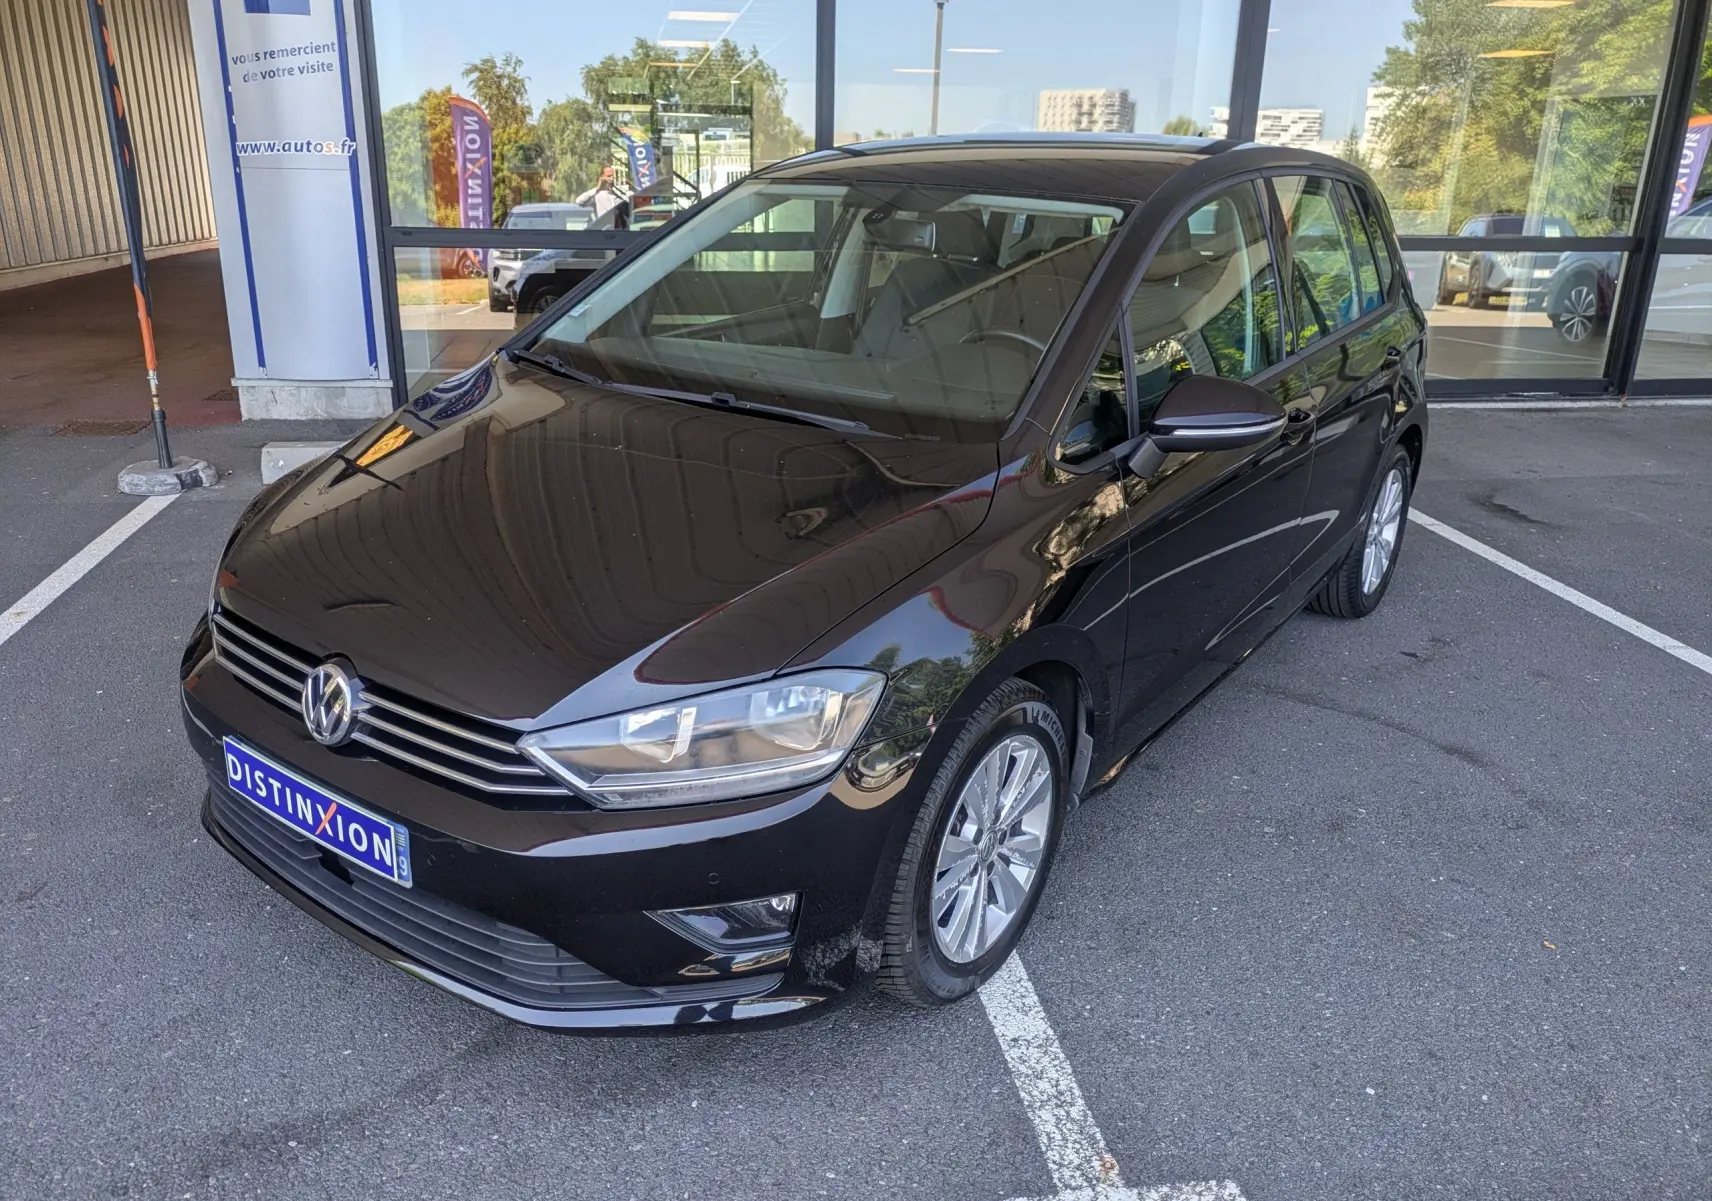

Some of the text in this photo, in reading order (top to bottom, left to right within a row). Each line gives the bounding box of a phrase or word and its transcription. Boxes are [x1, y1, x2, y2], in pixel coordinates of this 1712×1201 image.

[232, 41, 337, 66] vous remercient
[243, 60, 334, 83] de votre visite
[236, 138, 356, 155] www.autos.fr
[226, 752, 393, 868] DISTINXION
